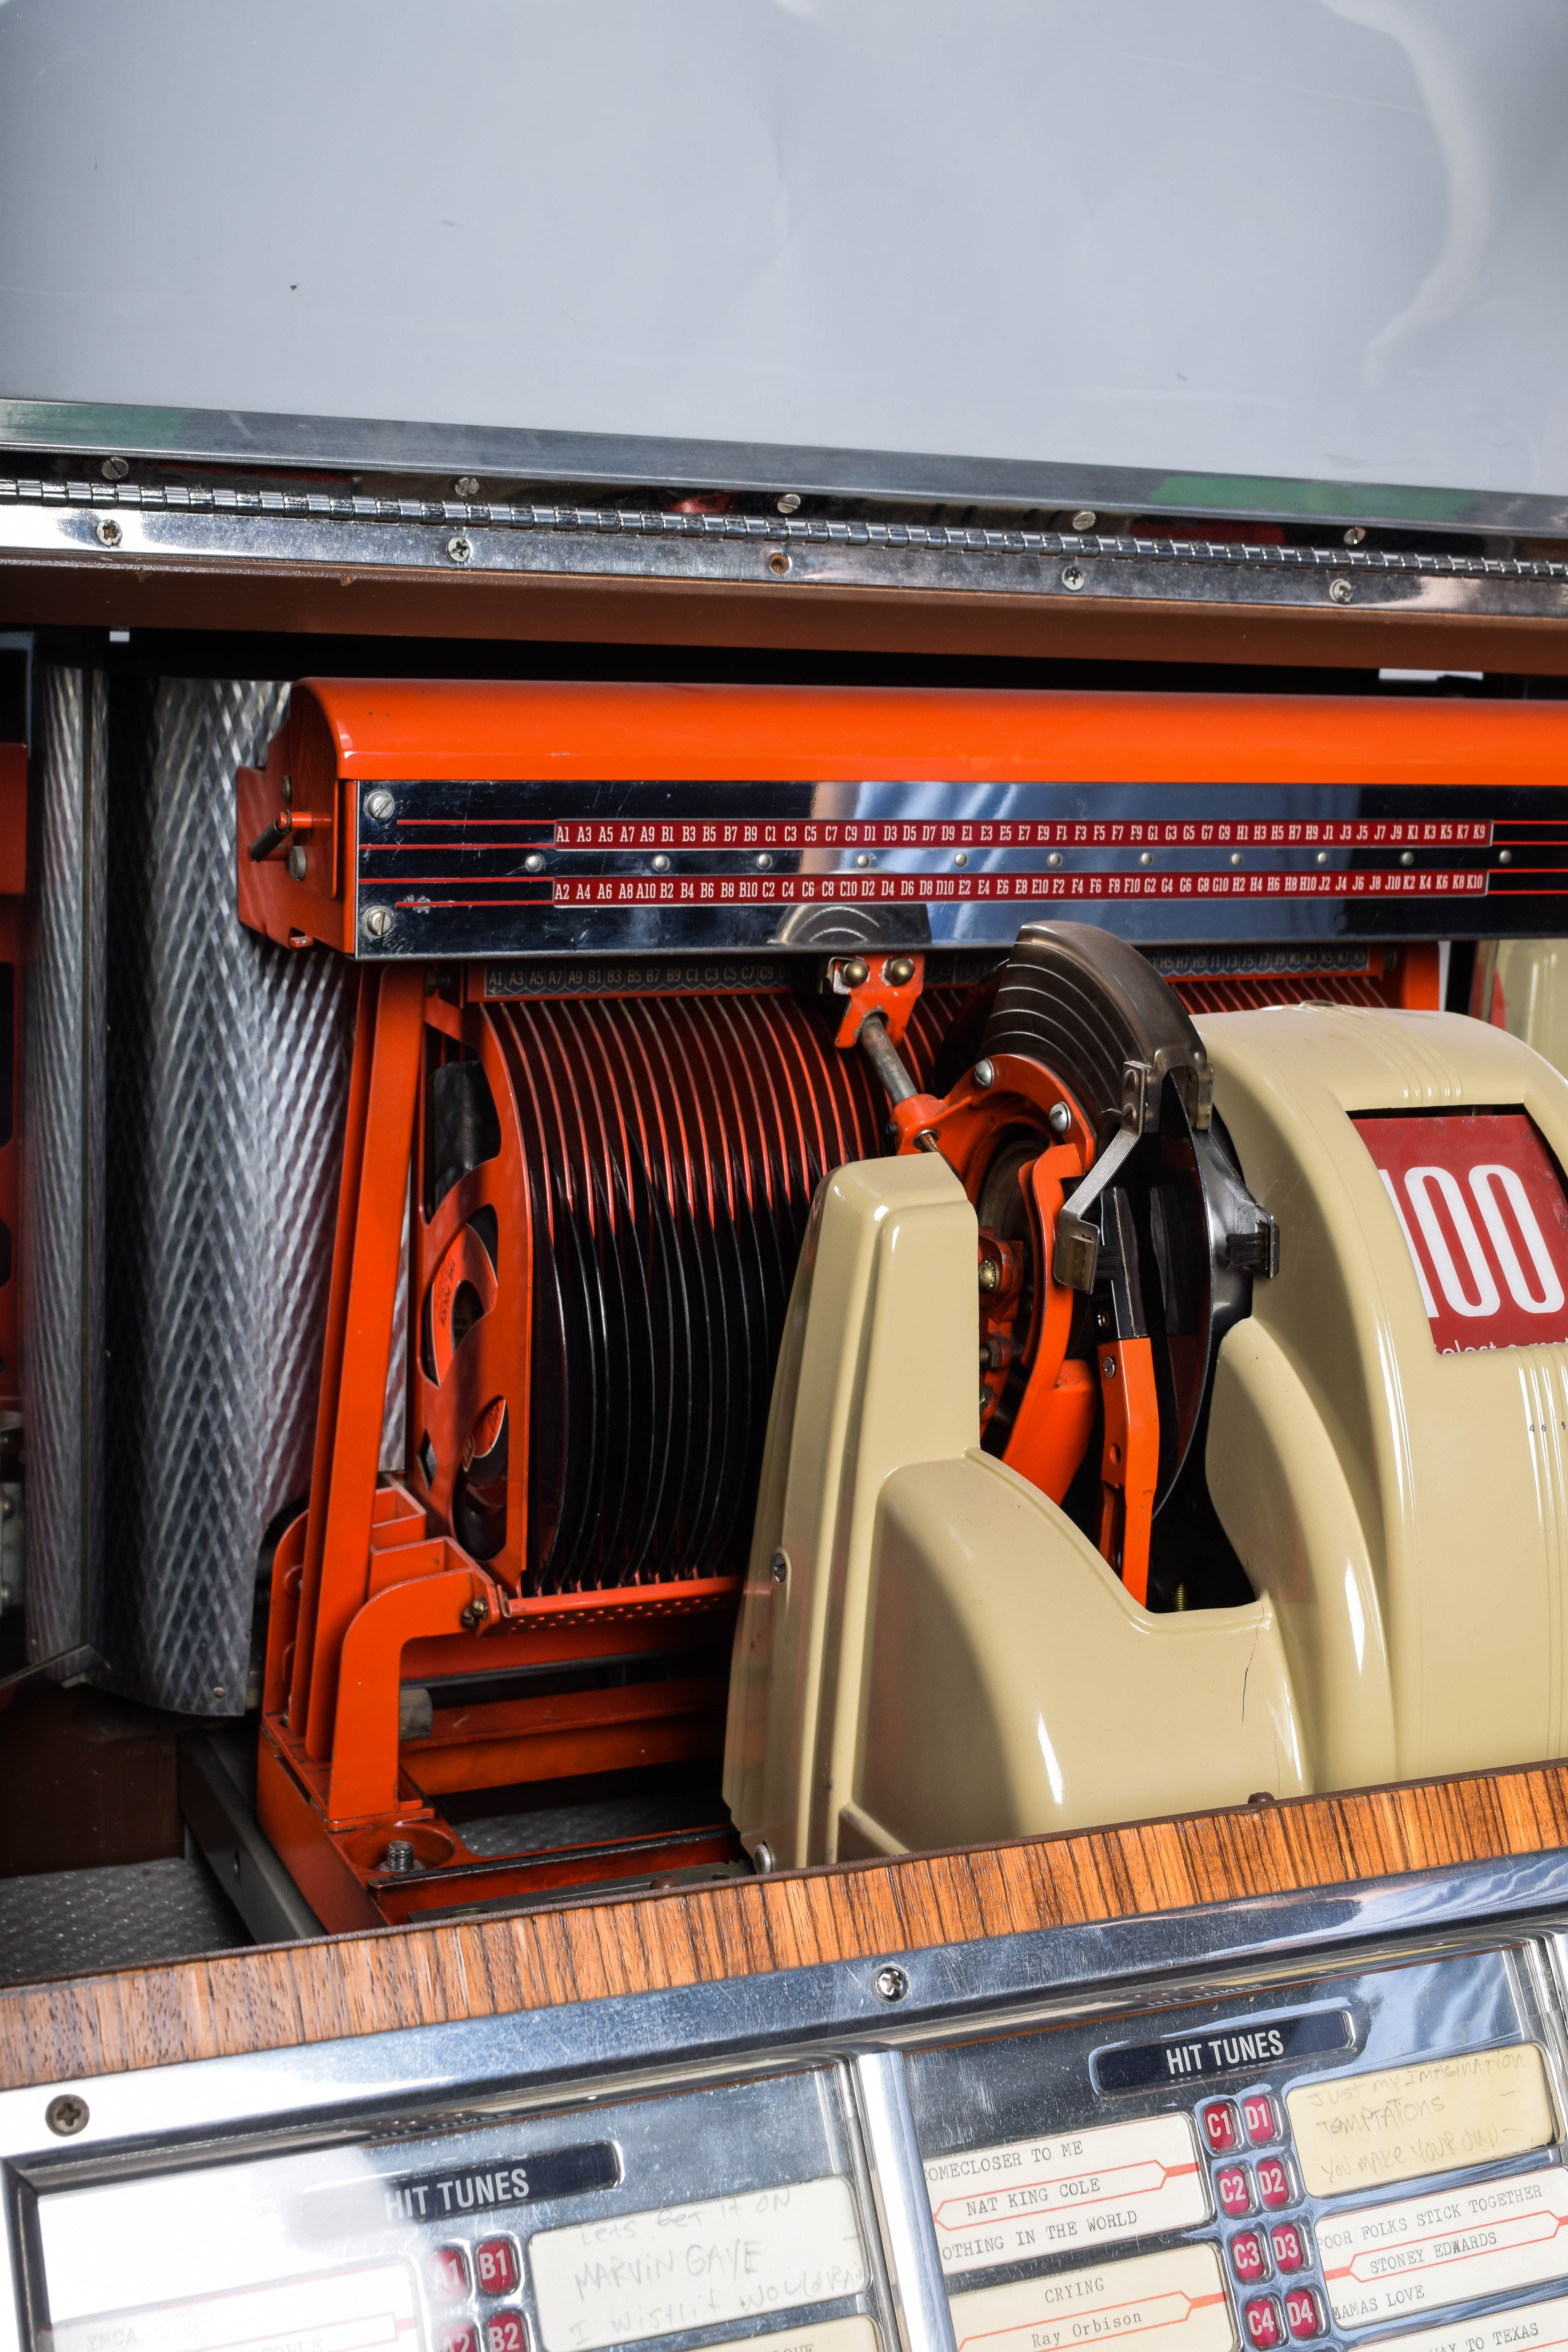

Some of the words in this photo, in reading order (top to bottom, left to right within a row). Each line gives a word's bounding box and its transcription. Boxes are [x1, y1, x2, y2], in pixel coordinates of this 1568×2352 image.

[555, 826, 570, 842] A1
[577, 826, 592, 842] A3
[598, 826, 613, 842] A5
[619, 826, 635, 842] A7
[639, 826, 655, 842] A9
[661, 826, 674, 842] B1
[682, 826, 696, 842] B3
[702, 826, 716, 842] B5
[724, 826, 737, 842] B7
[744, 826, 757, 842] B9
[765, 826, 777, 842] C1
[784, 826, 797, 842] C3
[804, 826, 817, 842] C5
[825, 825, 838, 842] C7
[845, 825, 857, 842] C9
[864, 825, 876, 841] D1
[883, 825, 897, 841] D3
[902, 825, 916, 841] D5
[922, 825, 937, 841] D7
[941, 825, 955, 841] D9
[961, 825, 973, 841] E1
[980, 825, 993, 841] E3
[999, 825, 1012, 841] E5
[1018, 825, 1031, 840] E7
[1037, 825, 1050, 840] E9
[1056, 825, 1067, 840] F1
[1074, 825, 1087, 840] F3
[1093, 825, 1105, 840] F5
[1111, 825, 1124, 840] F7
[1130, 825, 1142, 840] F9
[1147, 825, 1158, 840] G1
[1165, 825, 1177, 840] G3
[1183, 825, 1195, 840] G5
[1201, 825, 1213, 840] G7
[1218, 825, 1230, 840] G9
[1236, 825, 1248, 840] H1
[1253, 825, 1267, 840] H3
[1271, 825, 1284, 840] H5
[1288, 825, 1301, 840] H7
[1305, 825, 1318, 840] H9
[1323, 825, 1333, 840] J1
[1340, 825, 1352, 840] J3
[1356, 825, 1368, 840] J5
[1374, 825, 1386, 840] J7
[1390, 825, 1402, 840] J9
[1407, 825, 1418, 840] K1
[1424, 825, 1436, 839] K3
[1440, 824, 1452, 839] K5
[1457, 825, 1469, 839] K7
[1473, 824, 1485, 839] K9
[555, 884, 570, 900] A2
[575, 884, 591, 899] A4
[597, 883, 612, 899] A6
[618, 883, 633, 899] A8
[635, 883, 656, 899] A10
[660, 883, 674, 898] B2
[680, 882, 694, 898] B4
[700, 882, 714, 898] B6
[720, 882, 734, 898] B8
[739, 882, 758, 897] B10
[762, 882, 775, 898] C2
[782, 881, 794, 897] C4
[802, 881, 815, 897] C6
[822, 881, 834, 897] C8
[840, 881, 857, 897] C10
[861, 880, 875, 896] D2
[881, 880, 895, 896] D4
[900, 880, 915, 896] D6
[919, 880, 933, 895] D8
[936, 880, 954, 895] D10
[958, 880, 971, 895] E2
[977, 879, 990, 895] E4
[996, 879, 1009, 895] E6
[1015, 879, 1028, 894] E8
[1031, 879, 1049, 894] E10
[1052, 878, 1065, 894] F2
[1071, 878, 1083, 894] F4
[1089, 878, 1102, 893] F6
[1108, 878, 1120, 893] F8
[1124, 878, 1140, 893] F10
[1144, 878, 1156, 893] G2
[1161, 878, 1173, 893] G4
[1180, 877, 1192, 893] G6
[1198, 877, 1210, 892] G8
[1212, 877, 1229, 892] G10
[1232, 877, 1245, 892] H2
[1250, 877, 1263, 891] H4
[1267, 877, 1280, 891] H6
[1284, 877, 1297, 891] H8
[1299, 877, 1317, 891] H10
[1319, 876, 1331, 891] J2
[1335, 876, 1347, 891] J4
[1352, 876, 1364, 890] J6
[1369, 875, 1381, 890] J8
[1385, 875, 1401, 890] J10
[1403, 875, 1416, 890] K2
[1419, 875, 1431, 889] K4
[1436, 875, 1448, 889] K6
[1452, 875, 1465, 889] K8
[1466, 874, 1483, 889] K10
[1166, 2043, 1202, 2074] HIT
[1209, 2030, 1284, 2067] TUNES
[1207, 2111, 1232, 2138] C1
[1244, 2103, 1269, 2131] D1
[1031, 2147, 1051, 2162] TO
[1061, 2141, 1083, 2158] ME
[384, 2185, 428, 2220] HIT
[437, 2168, 529, 2210] TUNES
[1219, 2176, 1245, 2204] C2
[1257, 2168, 1284, 2195] D2
[966, 2197, 997, 2216] NAT
[1008, 2188, 1049, 2207] KING
[1060, 2178, 1100, 2196] COLE
[1317, 2231, 1353, 2250] POOR
[1362, 2218, 1407, 2240] FOLKS
[1416, 2204, 1461, 2227] STICK
[1468, 2184, 1543, 2213] TOGETHER
[939, 2236, 1004, 2260] OTHING
[1016, 2229, 1036, 2246] IN
[1045, 2221, 1078, 2240] THE
[1087, 2210, 1138, 2232] WORLD
[1272, 2233, 1298, 2261] D3
[479, 2249, 507, 2279] B1
[686, 2238, 762, 2281] GAYE
[1233, 2241, 1259, 2270] C3
[1370, 2250, 1425, 2274] STONEY
[1434, 2232, 1497, 2259] EDWARDS
[431, 2258, 460, 2290] A1
[1045, 2278, 1104, 2303] CRYING
[1332, 2298, 1378, 2320] MAMAS
[1386, 2285, 1425, 2307] LOVE
[1247, 2307, 1274, 2335] C4
[1286, 2299, 1313, 2328] D4
[86, 2331, 138, 2352] YMCA
[441, 2332, 470, 2352] A2
[489, 2322, 519, 2352] B2
[1031, 2331, 1060, 2349] Ray
[1073, 2313, 1142, 2337] Orbison
[1466, 2337, 1485, 2352] TO
[1492, 2323, 1539, 2345] TEXAS
